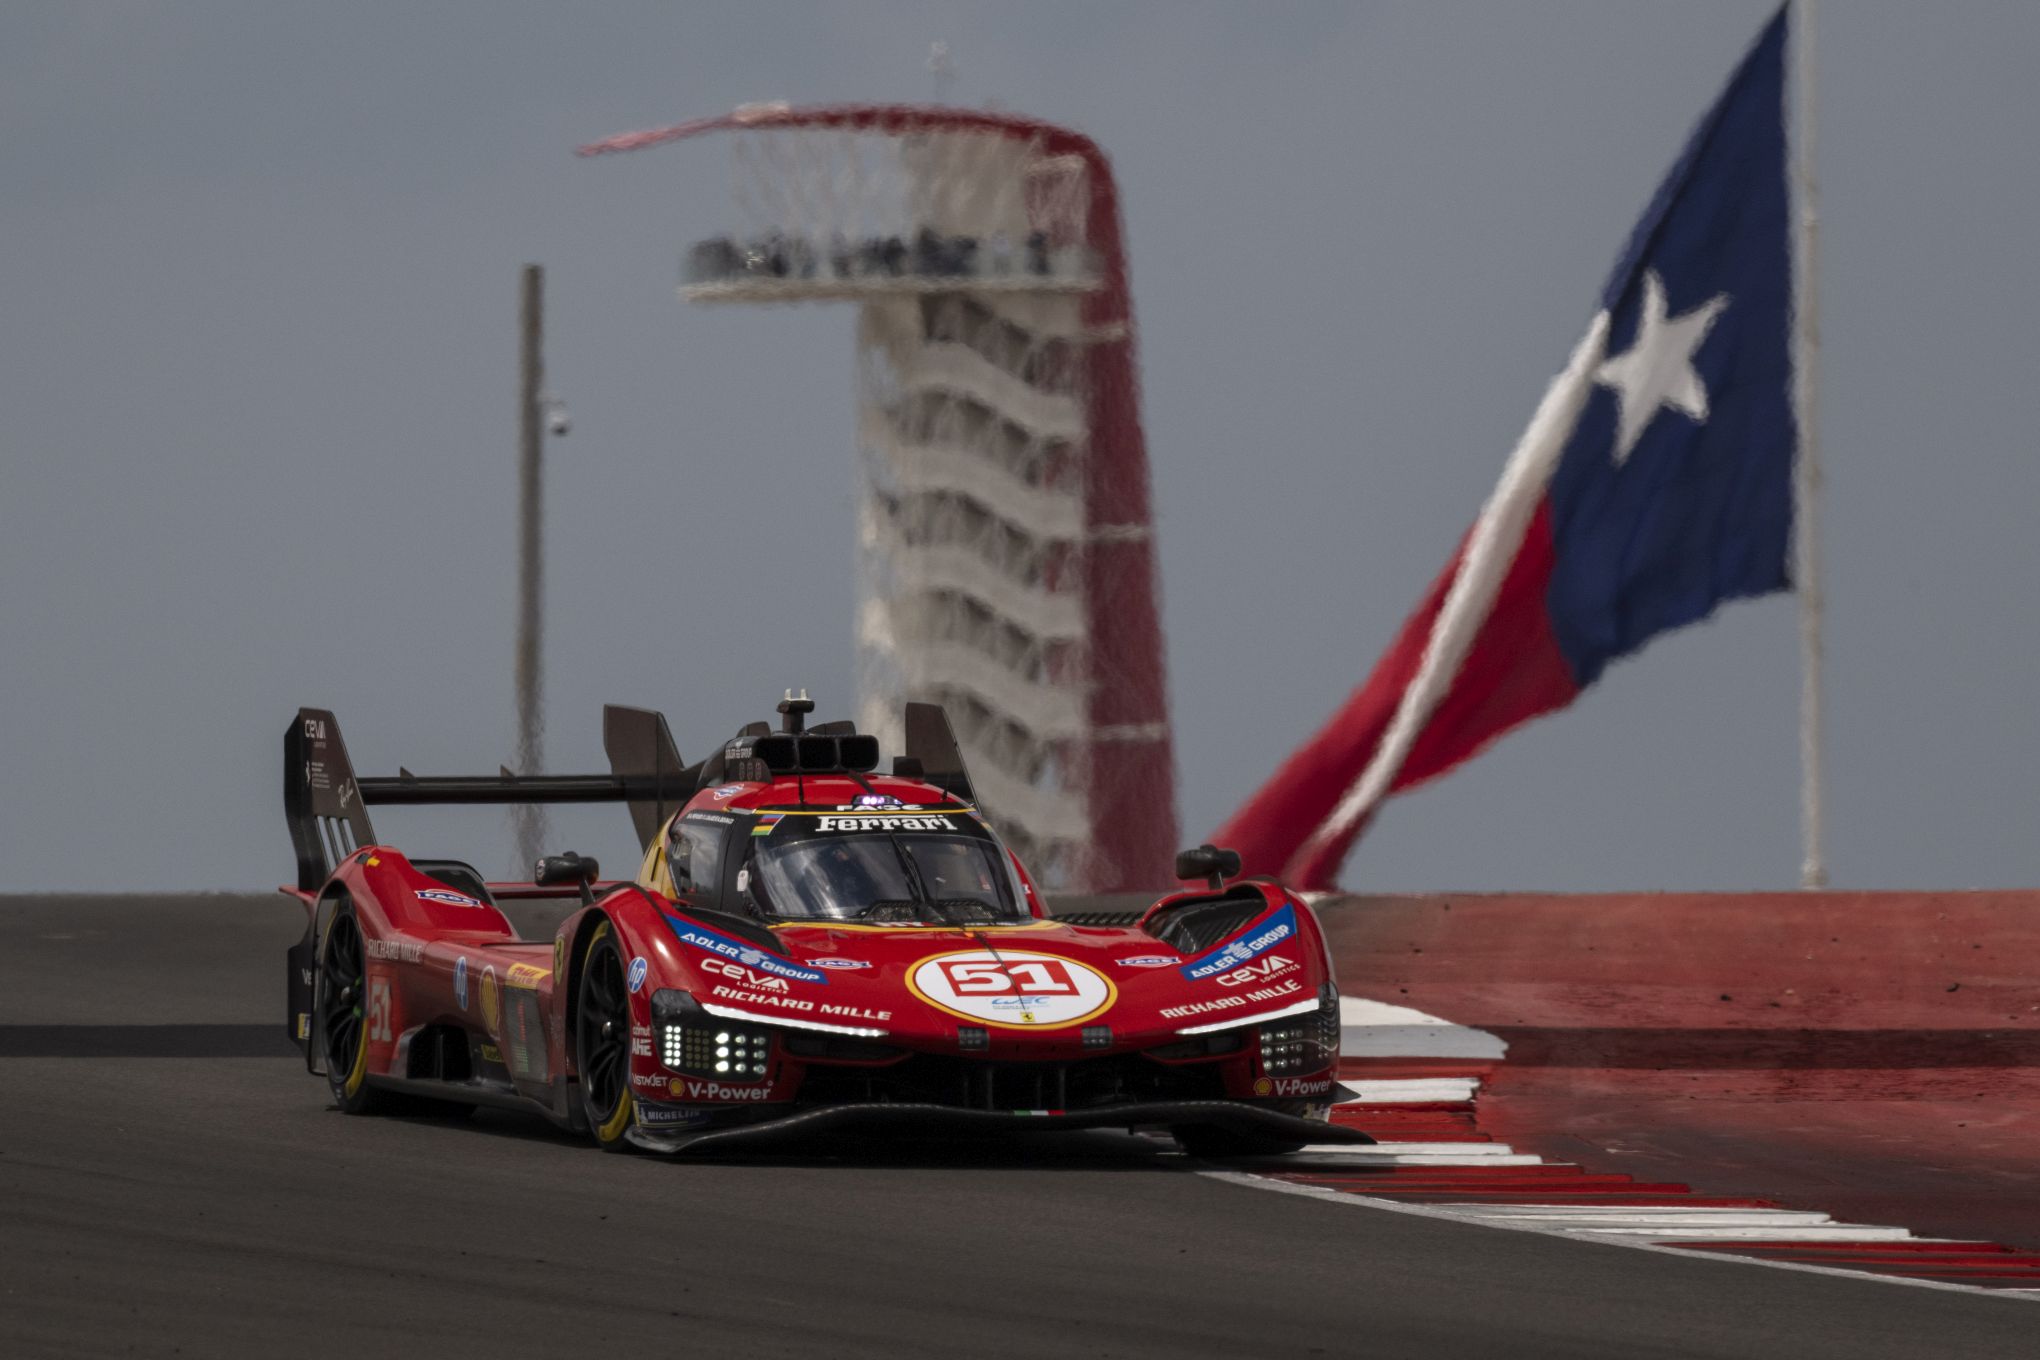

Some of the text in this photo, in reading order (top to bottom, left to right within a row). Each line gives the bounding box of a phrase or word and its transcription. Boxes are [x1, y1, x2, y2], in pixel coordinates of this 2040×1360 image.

[815, 814, 958, 832] Ferrari
[368, 939, 400, 960] RICHARD
[681, 933, 820, 981] ADLER GROUP
[1190, 924, 1290, 978] ADLER GROUP
[949, 963, 1071, 992] 51
[1260, 963, 1301, 983] LOGISTICS
[737, 981, 789, 995] LOGISTICS
[713, 985, 892, 1021] RICHARD MILLE
[1160, 979, 1302, 1019] RICHARD MILLE
[371, 983, 392, 1042] 51
[688, 1082, 771, 1099] V-Power
[1275, 1080, 1331, 1096] V-Power
[648, 1109, 700, 1121] MICHELIN
